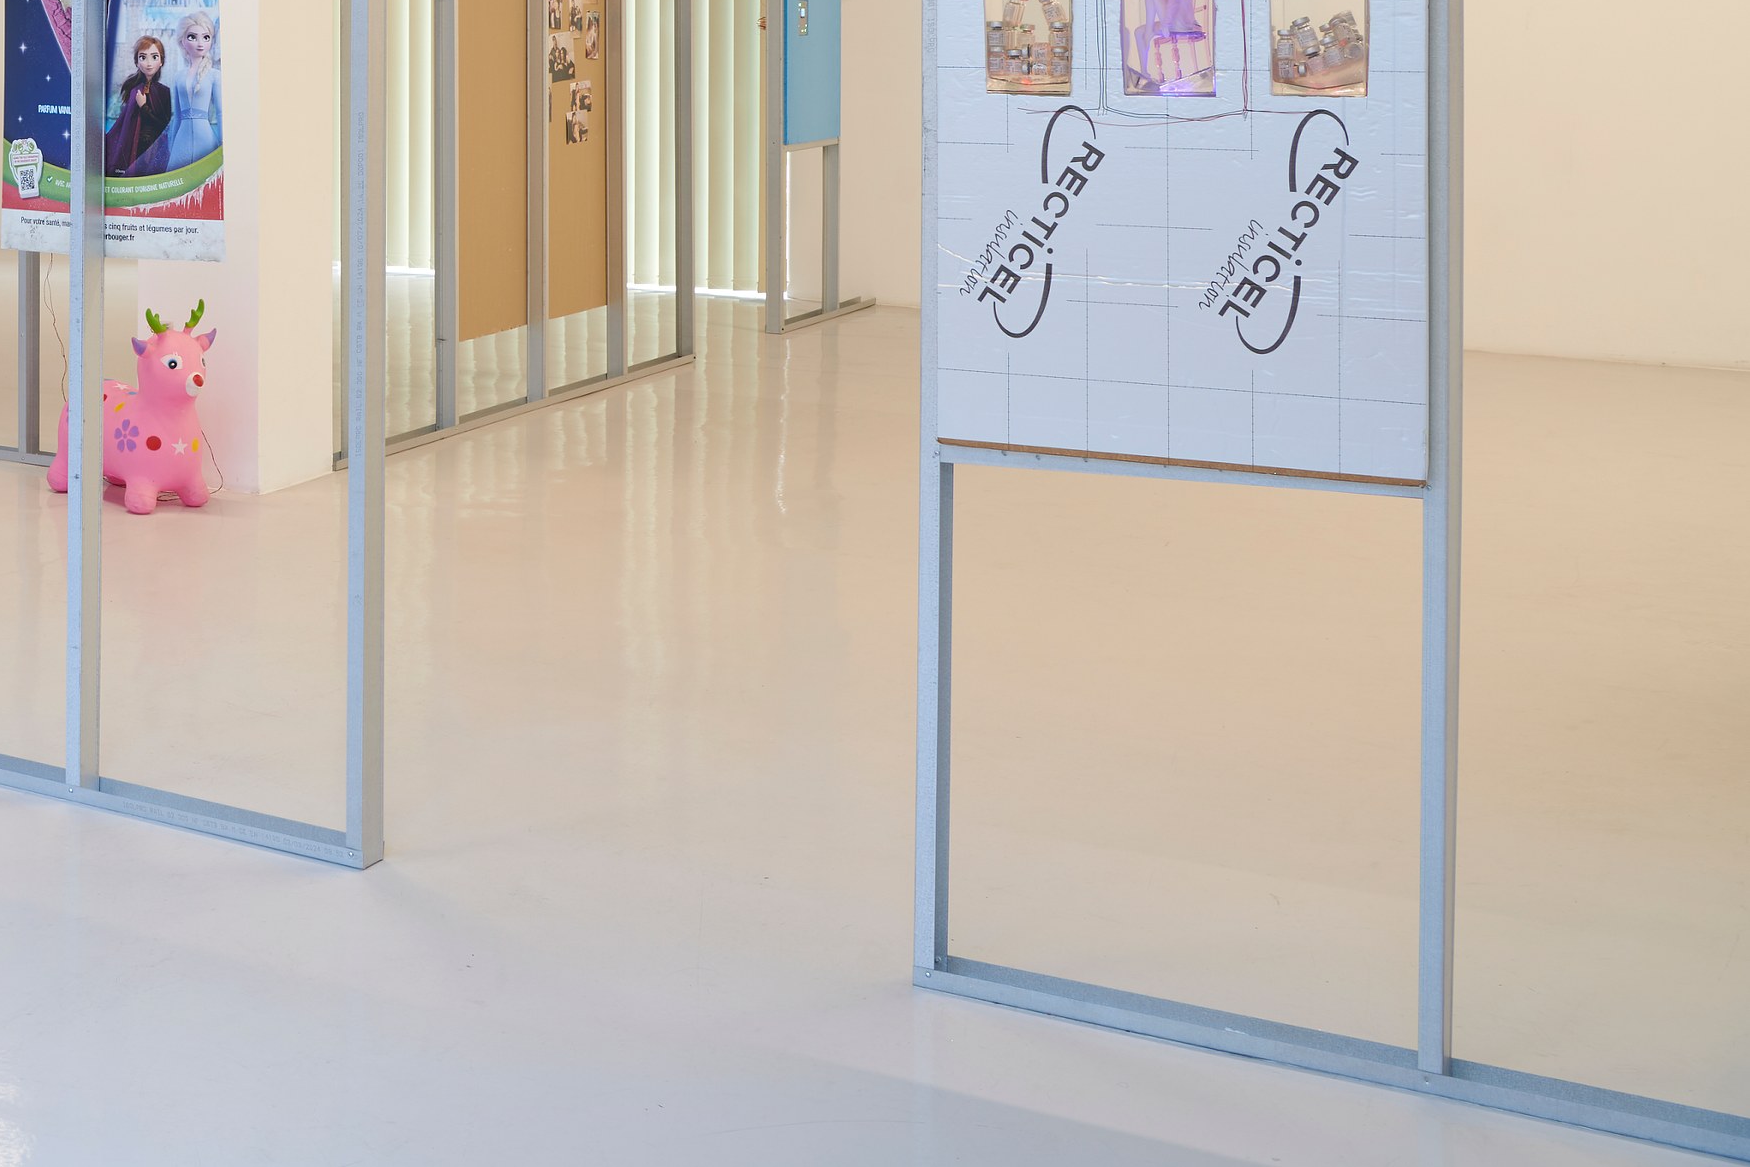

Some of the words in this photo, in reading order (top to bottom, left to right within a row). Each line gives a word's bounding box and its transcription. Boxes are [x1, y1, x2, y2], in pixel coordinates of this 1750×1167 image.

[159, 177, 184, 190] NATURELLE
[21, 216, 32, 224] Pour
[109, 223, 121, 231] cinq
[122, 223, 137, 231] fruits
[146, 224, 172, 233] légumes
[959, 209, 1019, 297] insulation
[1198, 219, 1264, 311] insulation
